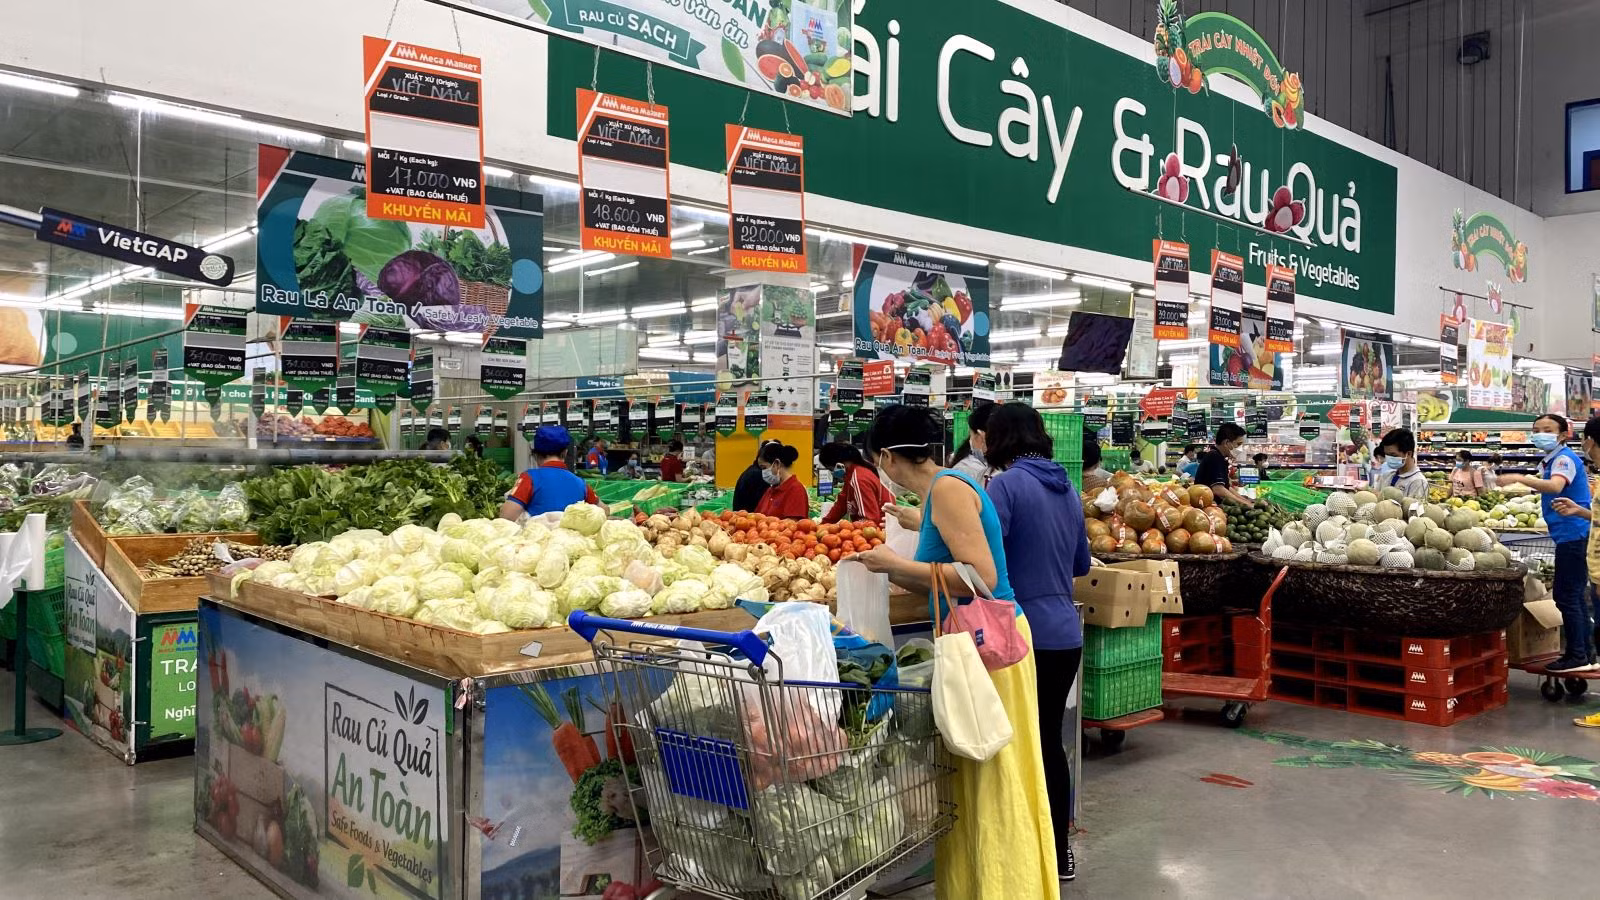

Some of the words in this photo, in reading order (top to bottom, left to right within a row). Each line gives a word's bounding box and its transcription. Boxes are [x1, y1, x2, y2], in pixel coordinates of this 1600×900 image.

[579, 10, 605, 23] RAU
[608, 13, 624, 27] CỦ
[628, 14, 677, 50] SẠCH
[723, 19, 749, 49] ăn
[1188, 32, 1212, 57] TRÁI
[1214, 28, 1233, 50] CÂY
[1235, 36, 1264, 70] NHIỆT
[404, 72, 424, 83] XUẤT
[431, 85, 470, 103] NAM
[937, 34, 1083, 204] Cây
[1111, 96, 1154, 191] &
[1176, 117, 1269, 224] Rau
[1286, 161, 1362, 253] Quả
[399, 155, 408, 164] Kg
[409, 156, 426, 166] (Each
[428, 158, 439, 167] kg):
[389, 166, 449, 189] 17.000
[453, 177, 477, 188] VNĐ
[385, 187, 405, 195] +VAT
[407, 188, 426, 198] (BAO
[446, 193, 469, 203] THUẾ)
[383, 201, 442, 221] KHUYẾN
[446, 208, 472, 223] MÃI
[593, 204, 640, 224] 18.600
[97, 227, 188, 263] VietGAP
[593, 234, 639, 251] KHUYẾN
[641, 240, 661, 254] MÃI
[741, 225, 784, 244] 22.000
[741, 255, 779, 268] KHUYẾN
[1249, 243, 1286, 268] Fruits
[1289, 251, 1299, 274] &
[1299, 255, 1360, 292] Vegetables
[262, 285, 299, 305] Rau
[303, 289, 331, 309] Lá
[333, 291, 360, 312] An
[365, 296, 407, 316] Toàn
[411, 302, 423, 318] /
[424, 308, 458, 323] Safety
[461, 311, 489, 327] Leafy
[491, 315, 539, 329] Vegetable
[855, 338, 872, 350] Rau
[893, 344, 906, 353] An
[332, 701, 362, 747] Rau
[366, 718, 388, 760] Củ
[393, 728, 432, 778] Quả
[331, 752, 365, 815] An
[369, 767, 434, 851] Toàn
[331, 810, 349, 836] Safe
[349, 820, 373, 850] Foods
[374, 842, 381, 855] &
[382, 840, 433, 887] Vegetables
